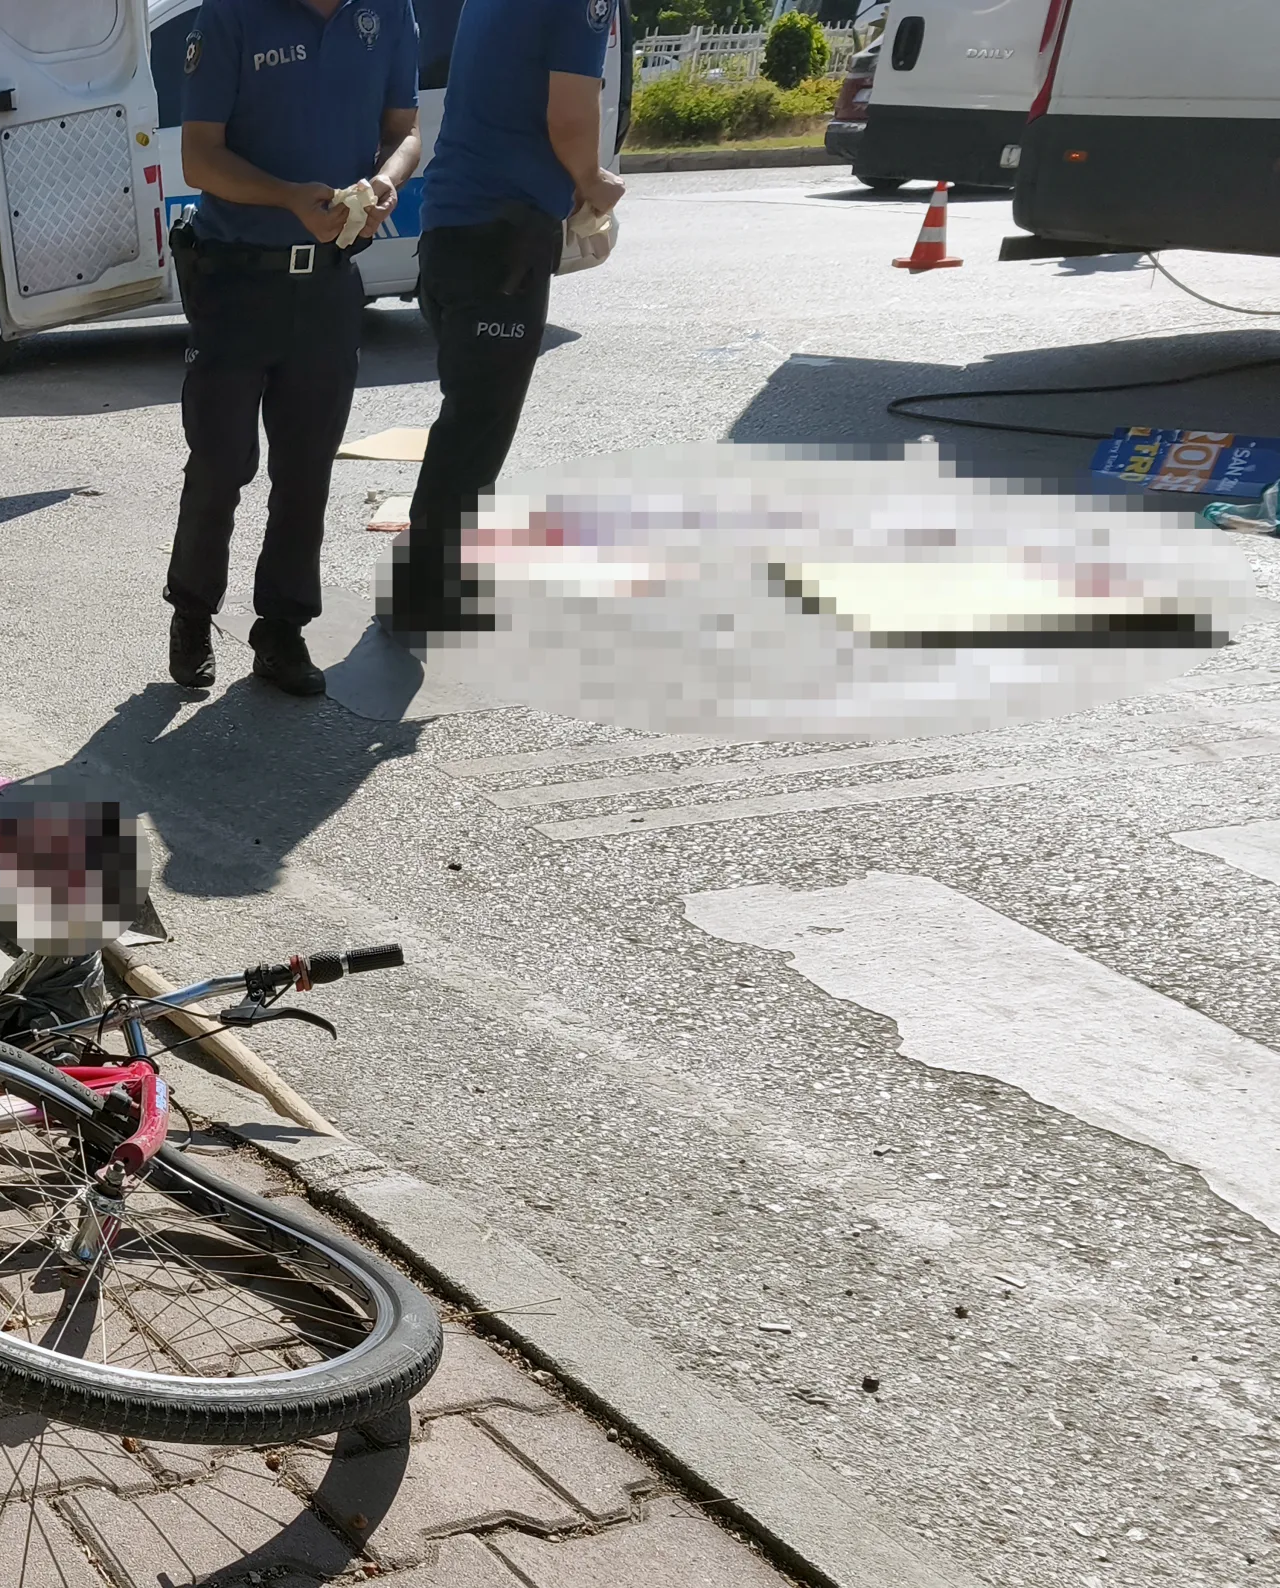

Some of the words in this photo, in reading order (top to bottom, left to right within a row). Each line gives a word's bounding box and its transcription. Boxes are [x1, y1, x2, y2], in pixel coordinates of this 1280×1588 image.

[253, 44, 308, 72] POLİS
[965, 47, 1016, 60] DAILY
[476, 321, 526, 339] POLİS
